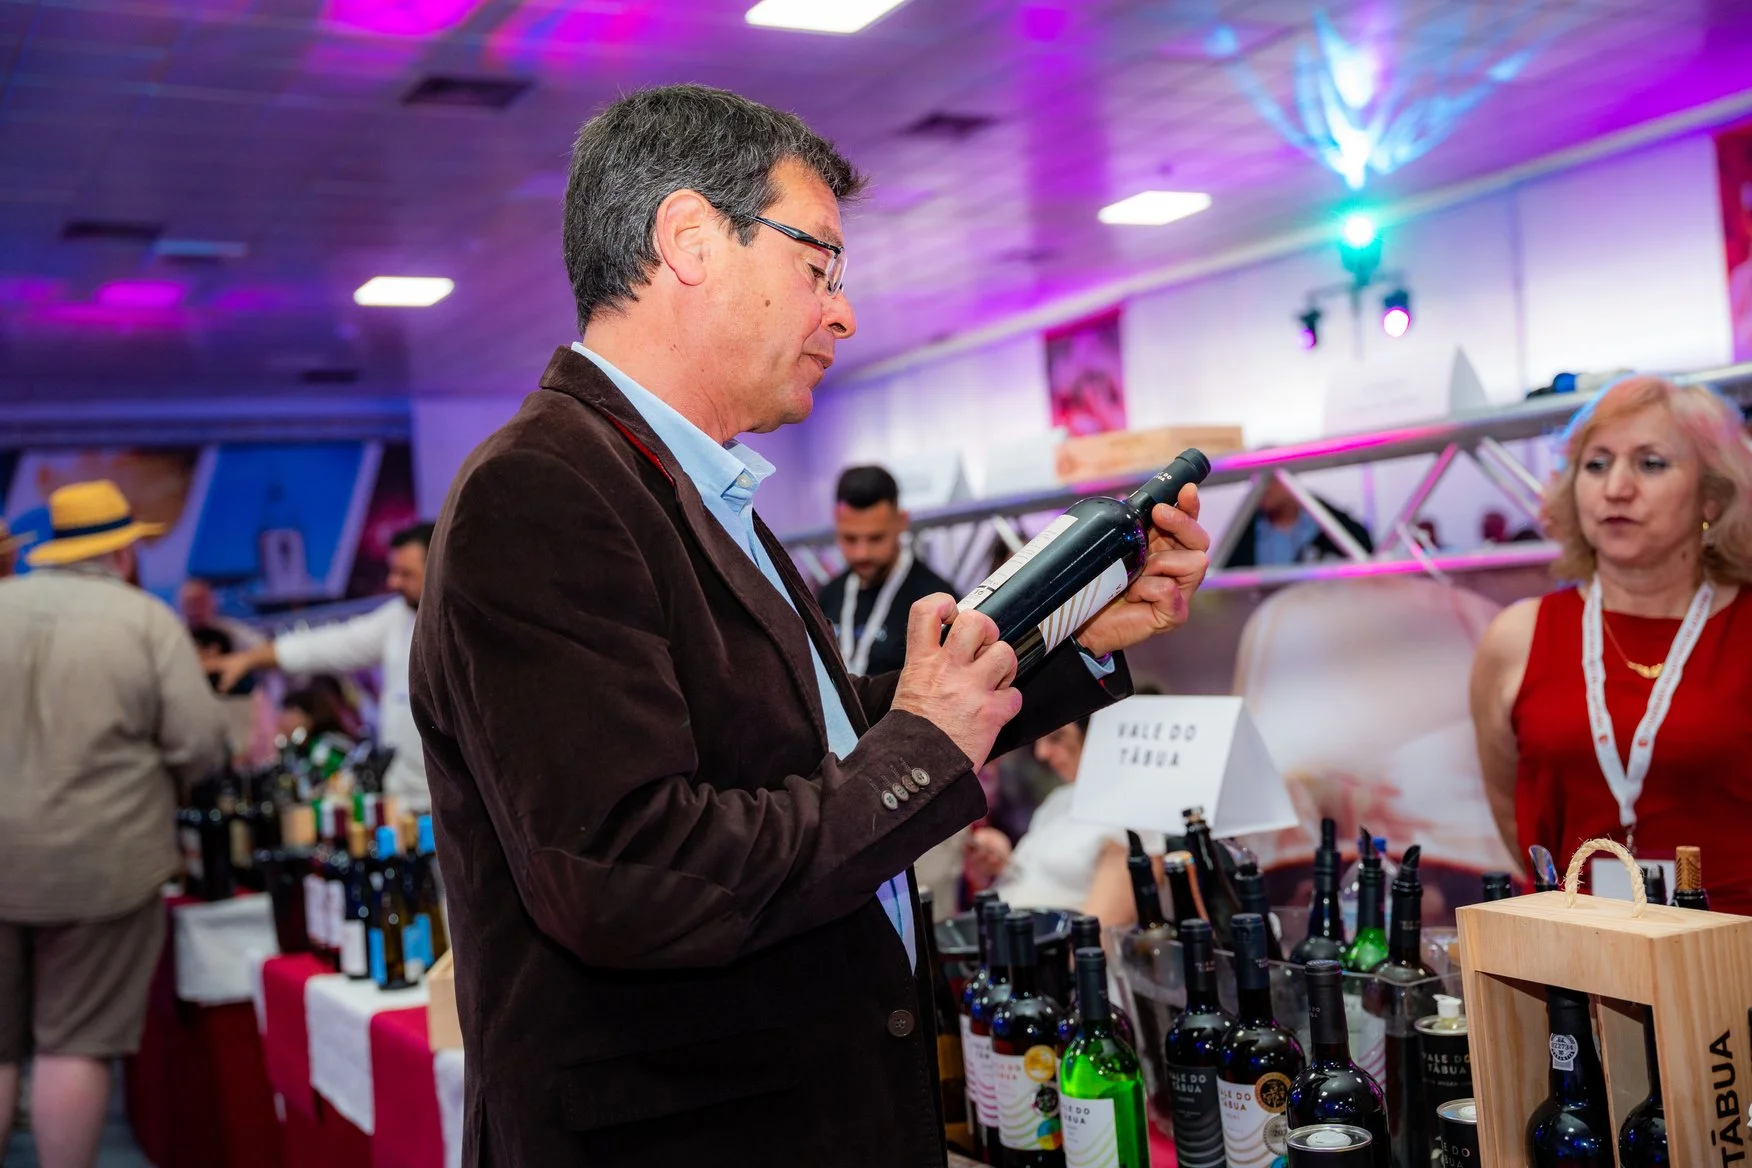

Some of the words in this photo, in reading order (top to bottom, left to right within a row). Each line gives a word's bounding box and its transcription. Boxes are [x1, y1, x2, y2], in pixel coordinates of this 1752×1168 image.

[1118, 722, 1162, 740] VALE
[1169, 724, 1197, 743] DO
[1421, 1051, 1449, 1064] VALE
[1190, 1074, 1207, 1084] DO
[1236, 1091, 1252, 1101] DO
[1075, 1106, 1090, 1115] DO
